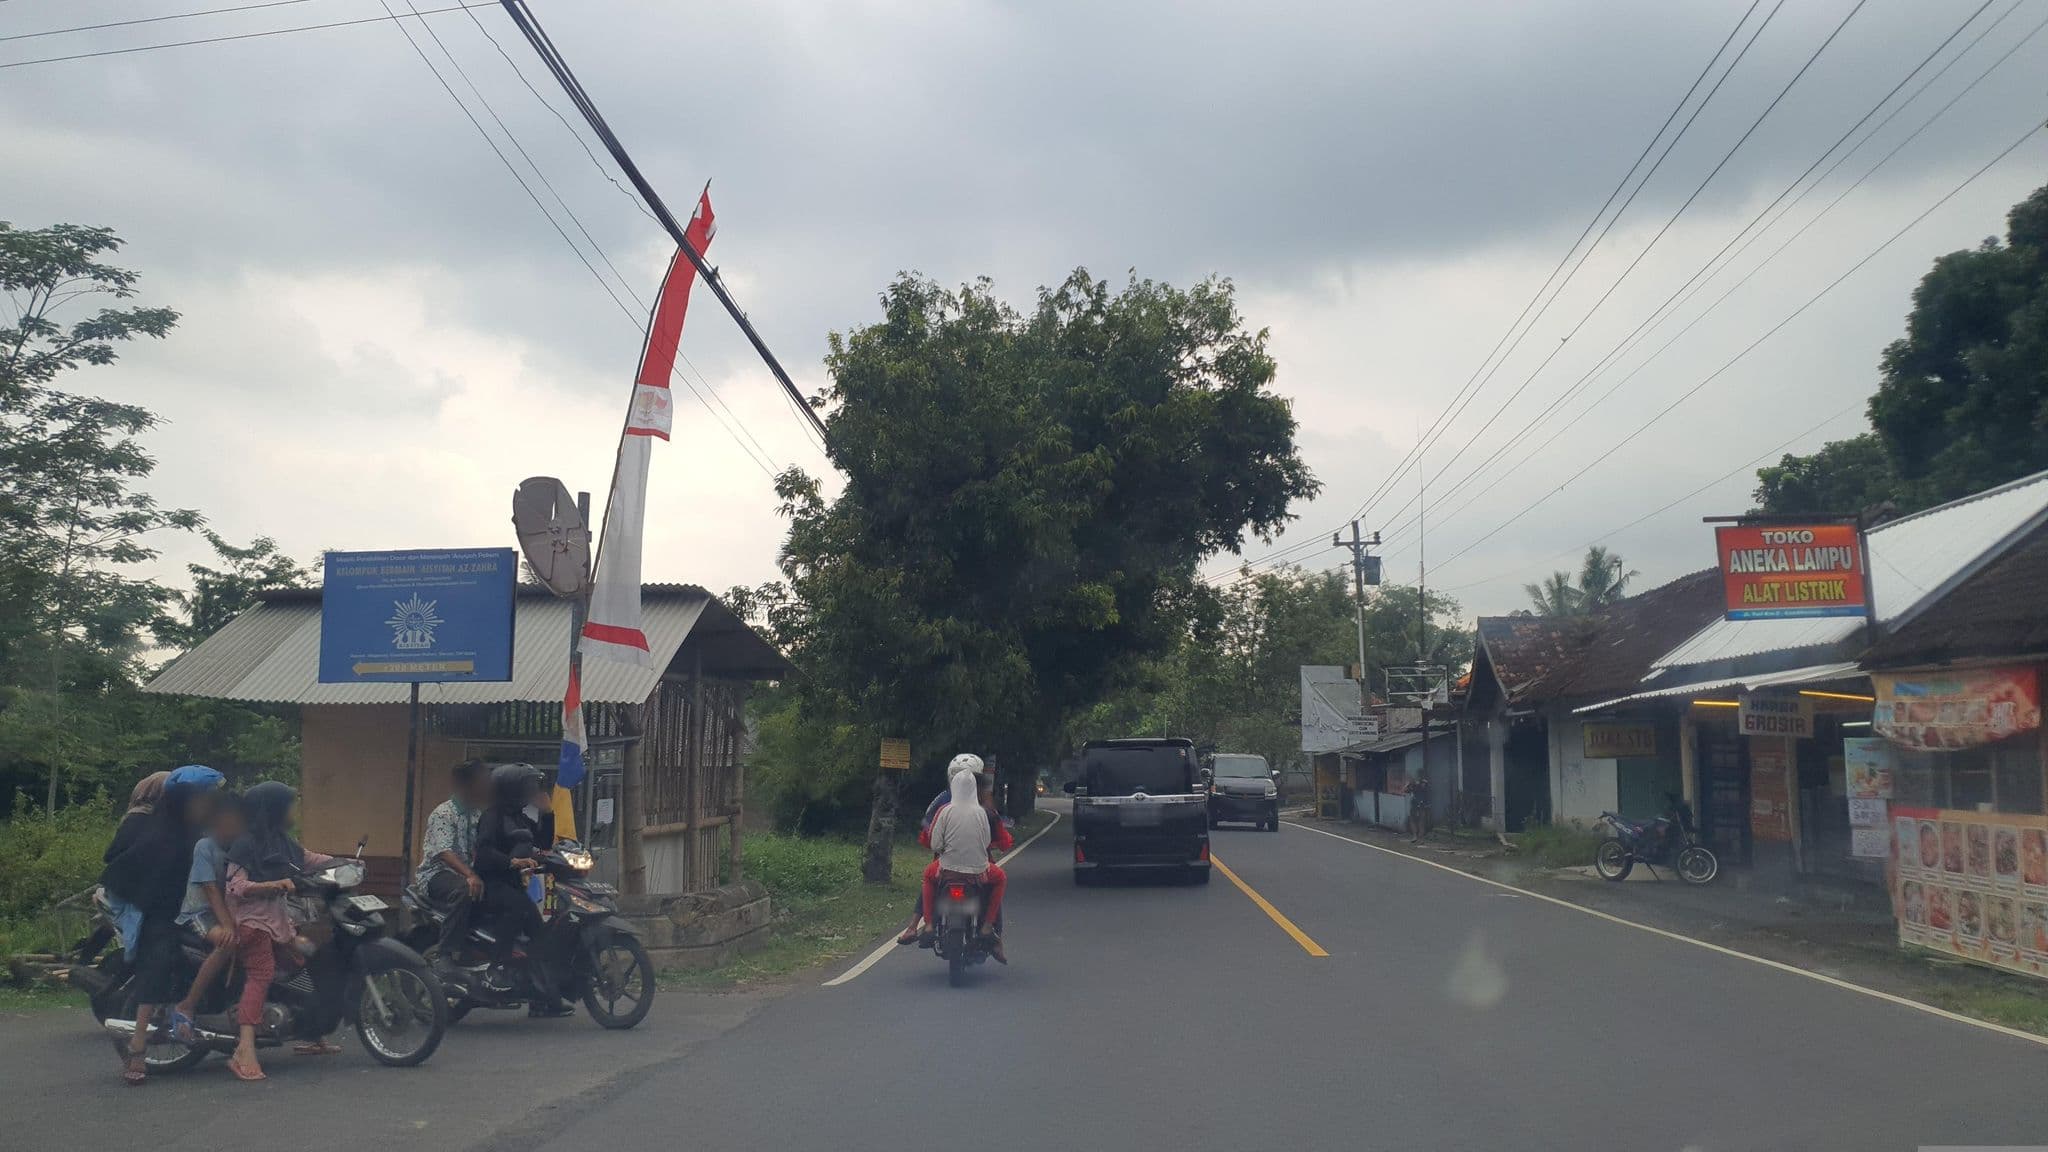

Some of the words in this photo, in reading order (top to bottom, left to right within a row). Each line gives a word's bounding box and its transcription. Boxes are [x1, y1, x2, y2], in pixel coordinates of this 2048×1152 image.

[1760, 530, 1814, 545] TOKO
[1730, 549, 1790, 573] ANEKA
[1793, 547, 1852, 571] LAMPU
[1744, 583, 1781, 603] ALAT
[1784, 580, 1846, 602] LISTRIK
[1745, 714, 1806, 733] GROSIR
